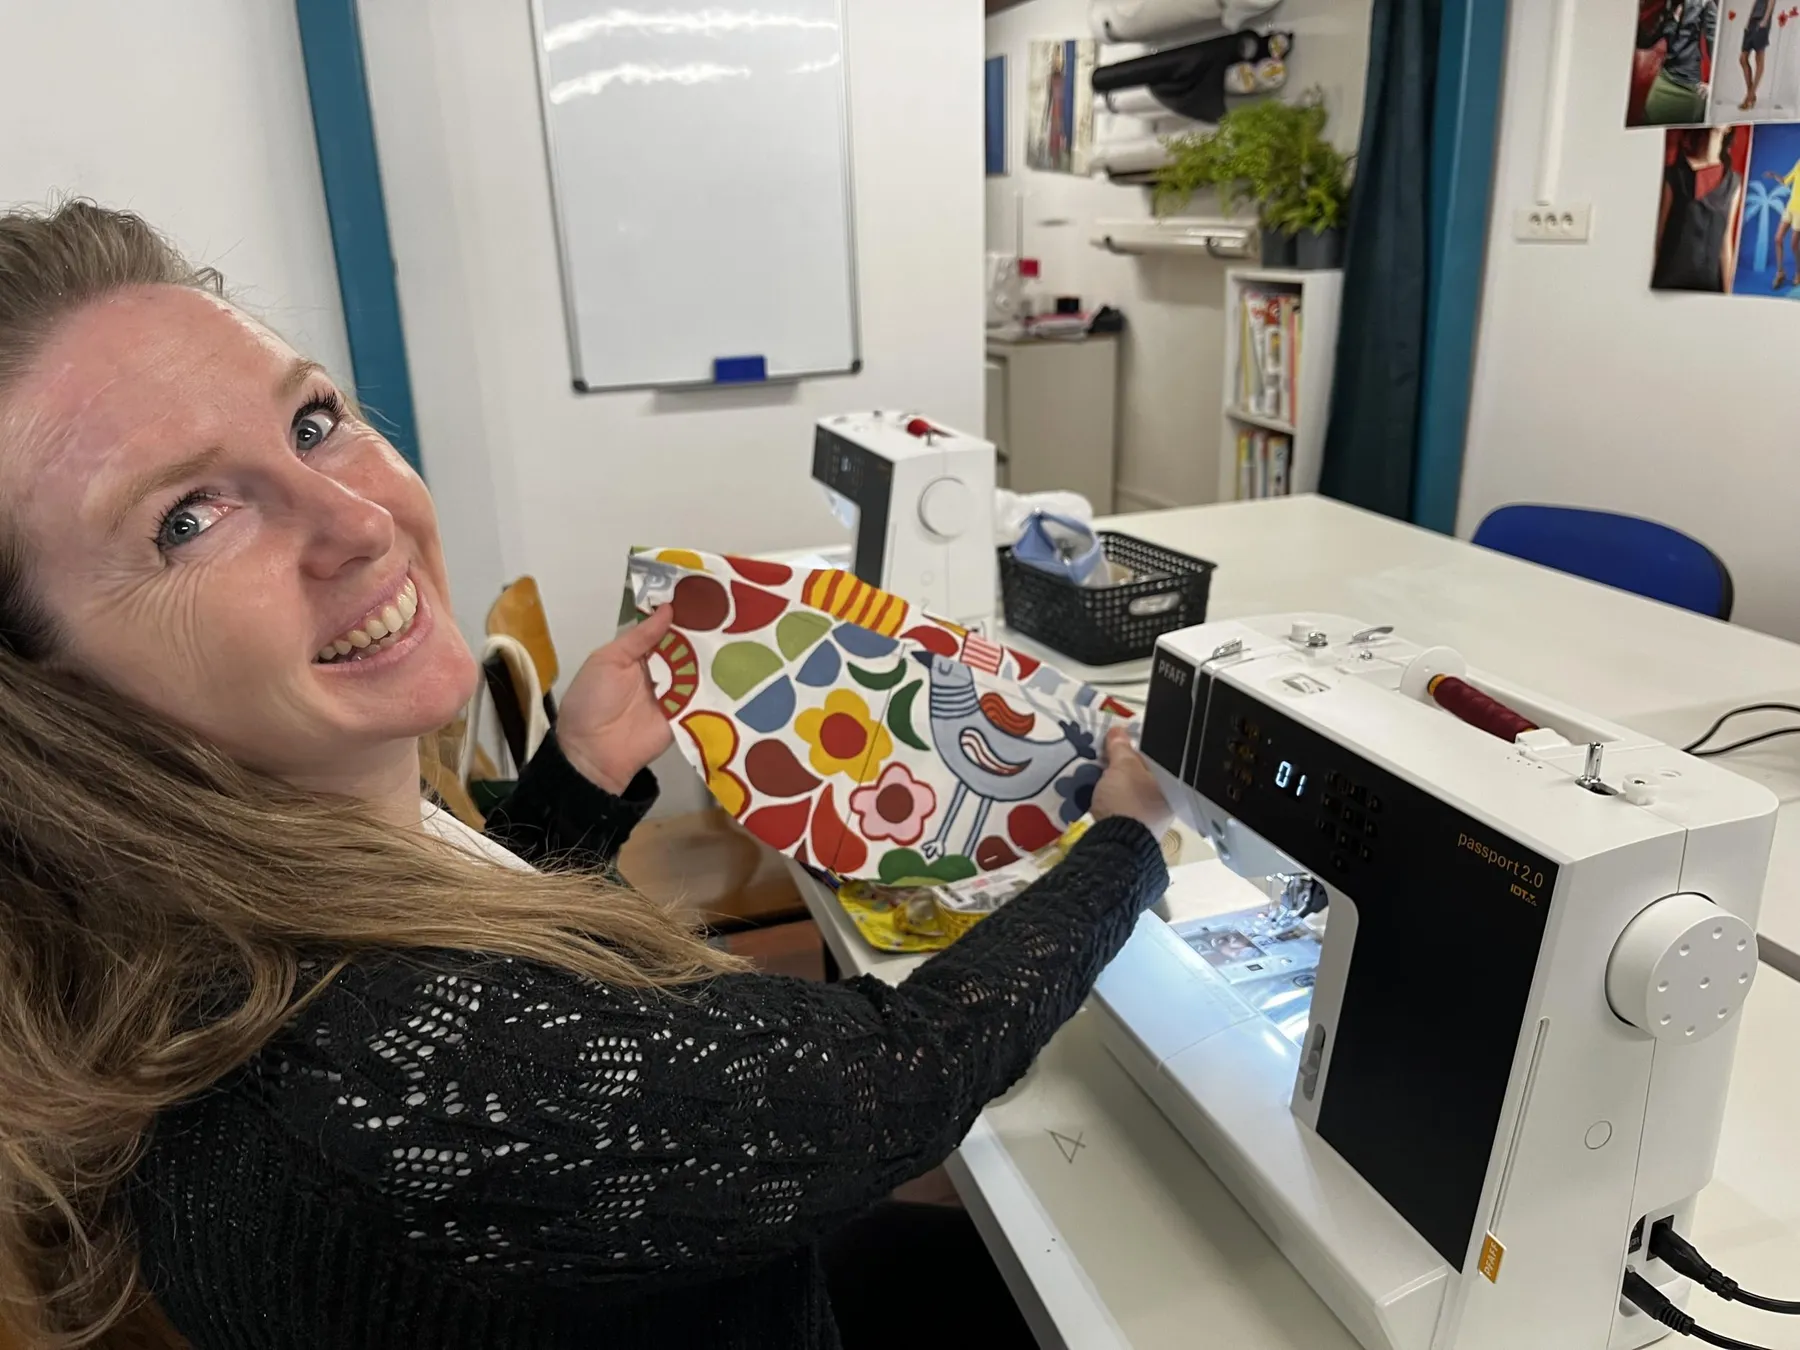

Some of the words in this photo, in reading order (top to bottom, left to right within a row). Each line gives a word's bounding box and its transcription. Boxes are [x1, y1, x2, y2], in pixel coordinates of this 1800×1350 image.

[1158, 660, 1188, 687] PFAFF
[1274, 760, 1308, 797] 01
[1457, 832, 1519, 876] passport
[1521, 864, 1544, 888] 2.0
[1483, 1241, 1499, 1277] PFAFF
